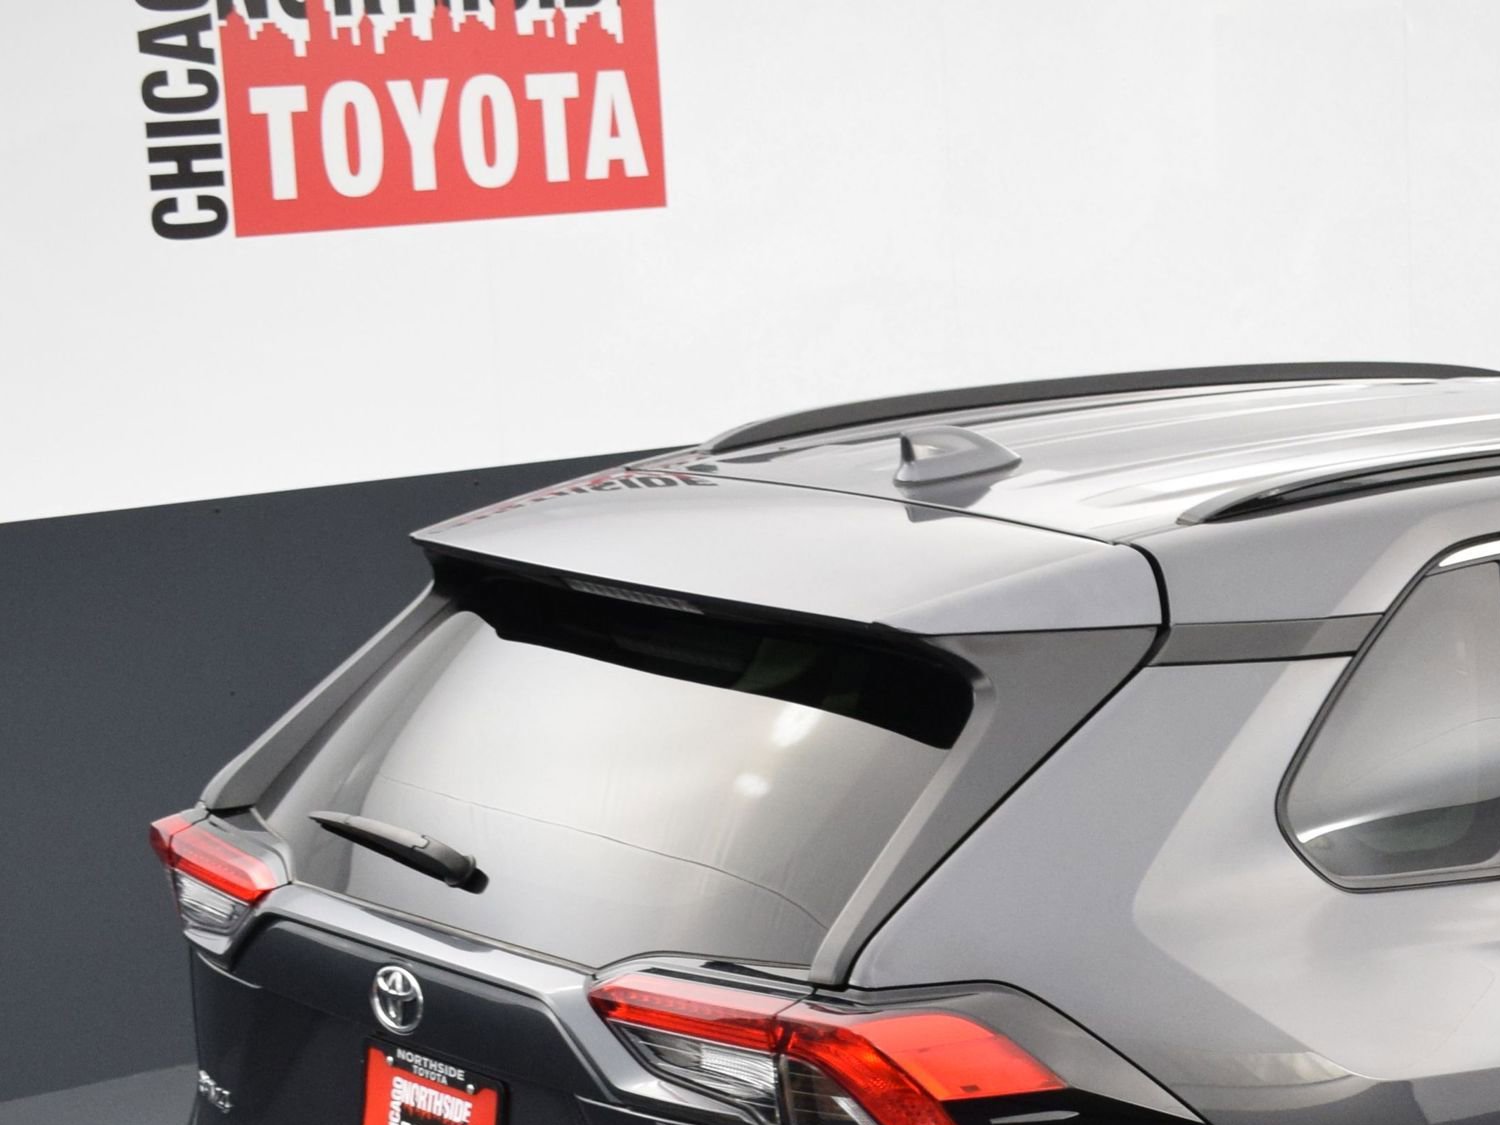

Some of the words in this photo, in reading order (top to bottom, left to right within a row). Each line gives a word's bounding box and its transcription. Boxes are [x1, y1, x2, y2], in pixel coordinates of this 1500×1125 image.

[136, 0, 229, 240] CHICA
[248, 69, 650, 200] TOYOTA
[396, 1048, 466, 1082] NORTHSIDE
[412, 1064, 449, 1086] TOYOTA
[399, 1079, 473, 1124] NORTHSIDE
